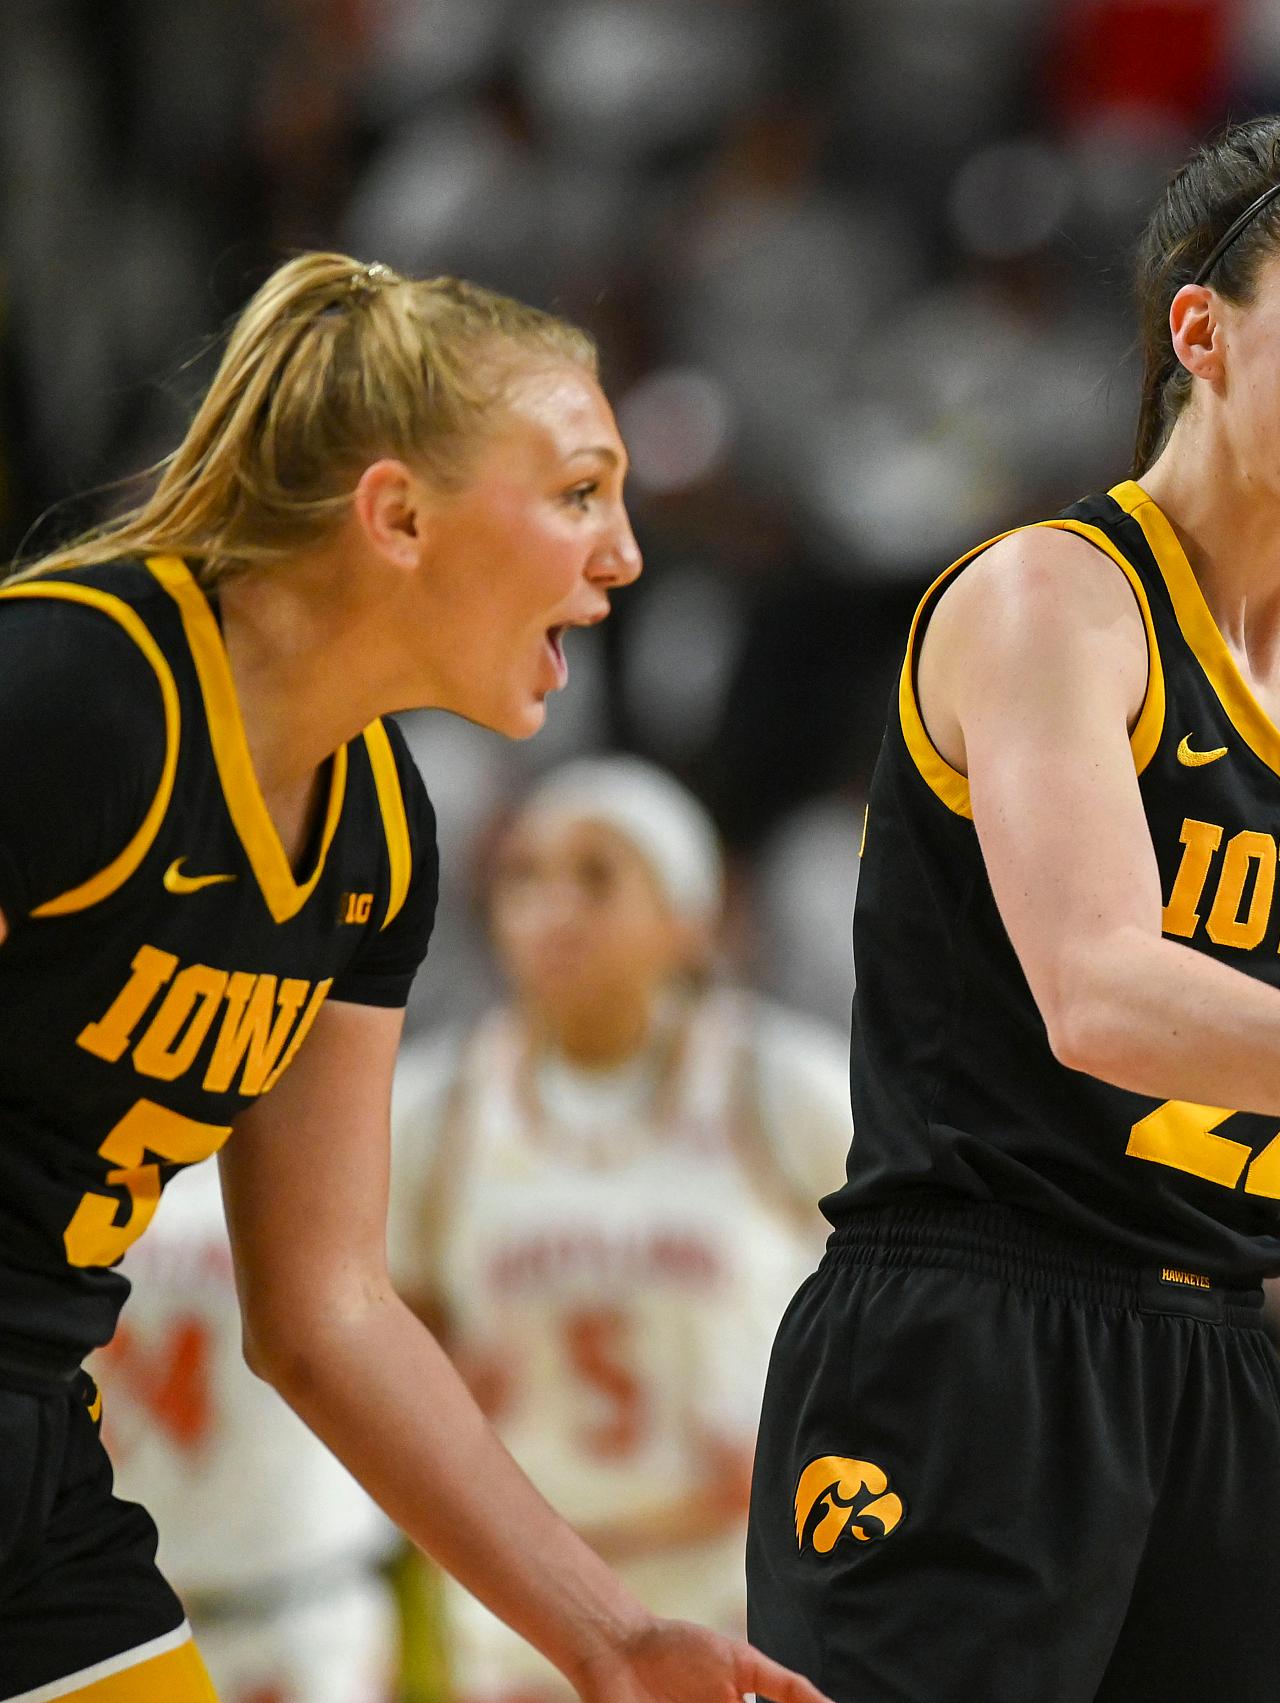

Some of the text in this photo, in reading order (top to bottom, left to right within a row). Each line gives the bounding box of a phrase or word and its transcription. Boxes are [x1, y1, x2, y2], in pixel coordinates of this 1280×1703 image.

[76, 944, 334, 1097] IOW
[63, 1099, 233, 1267] 5
[1161, 1267, 1210, 1288] HAWKEYES
